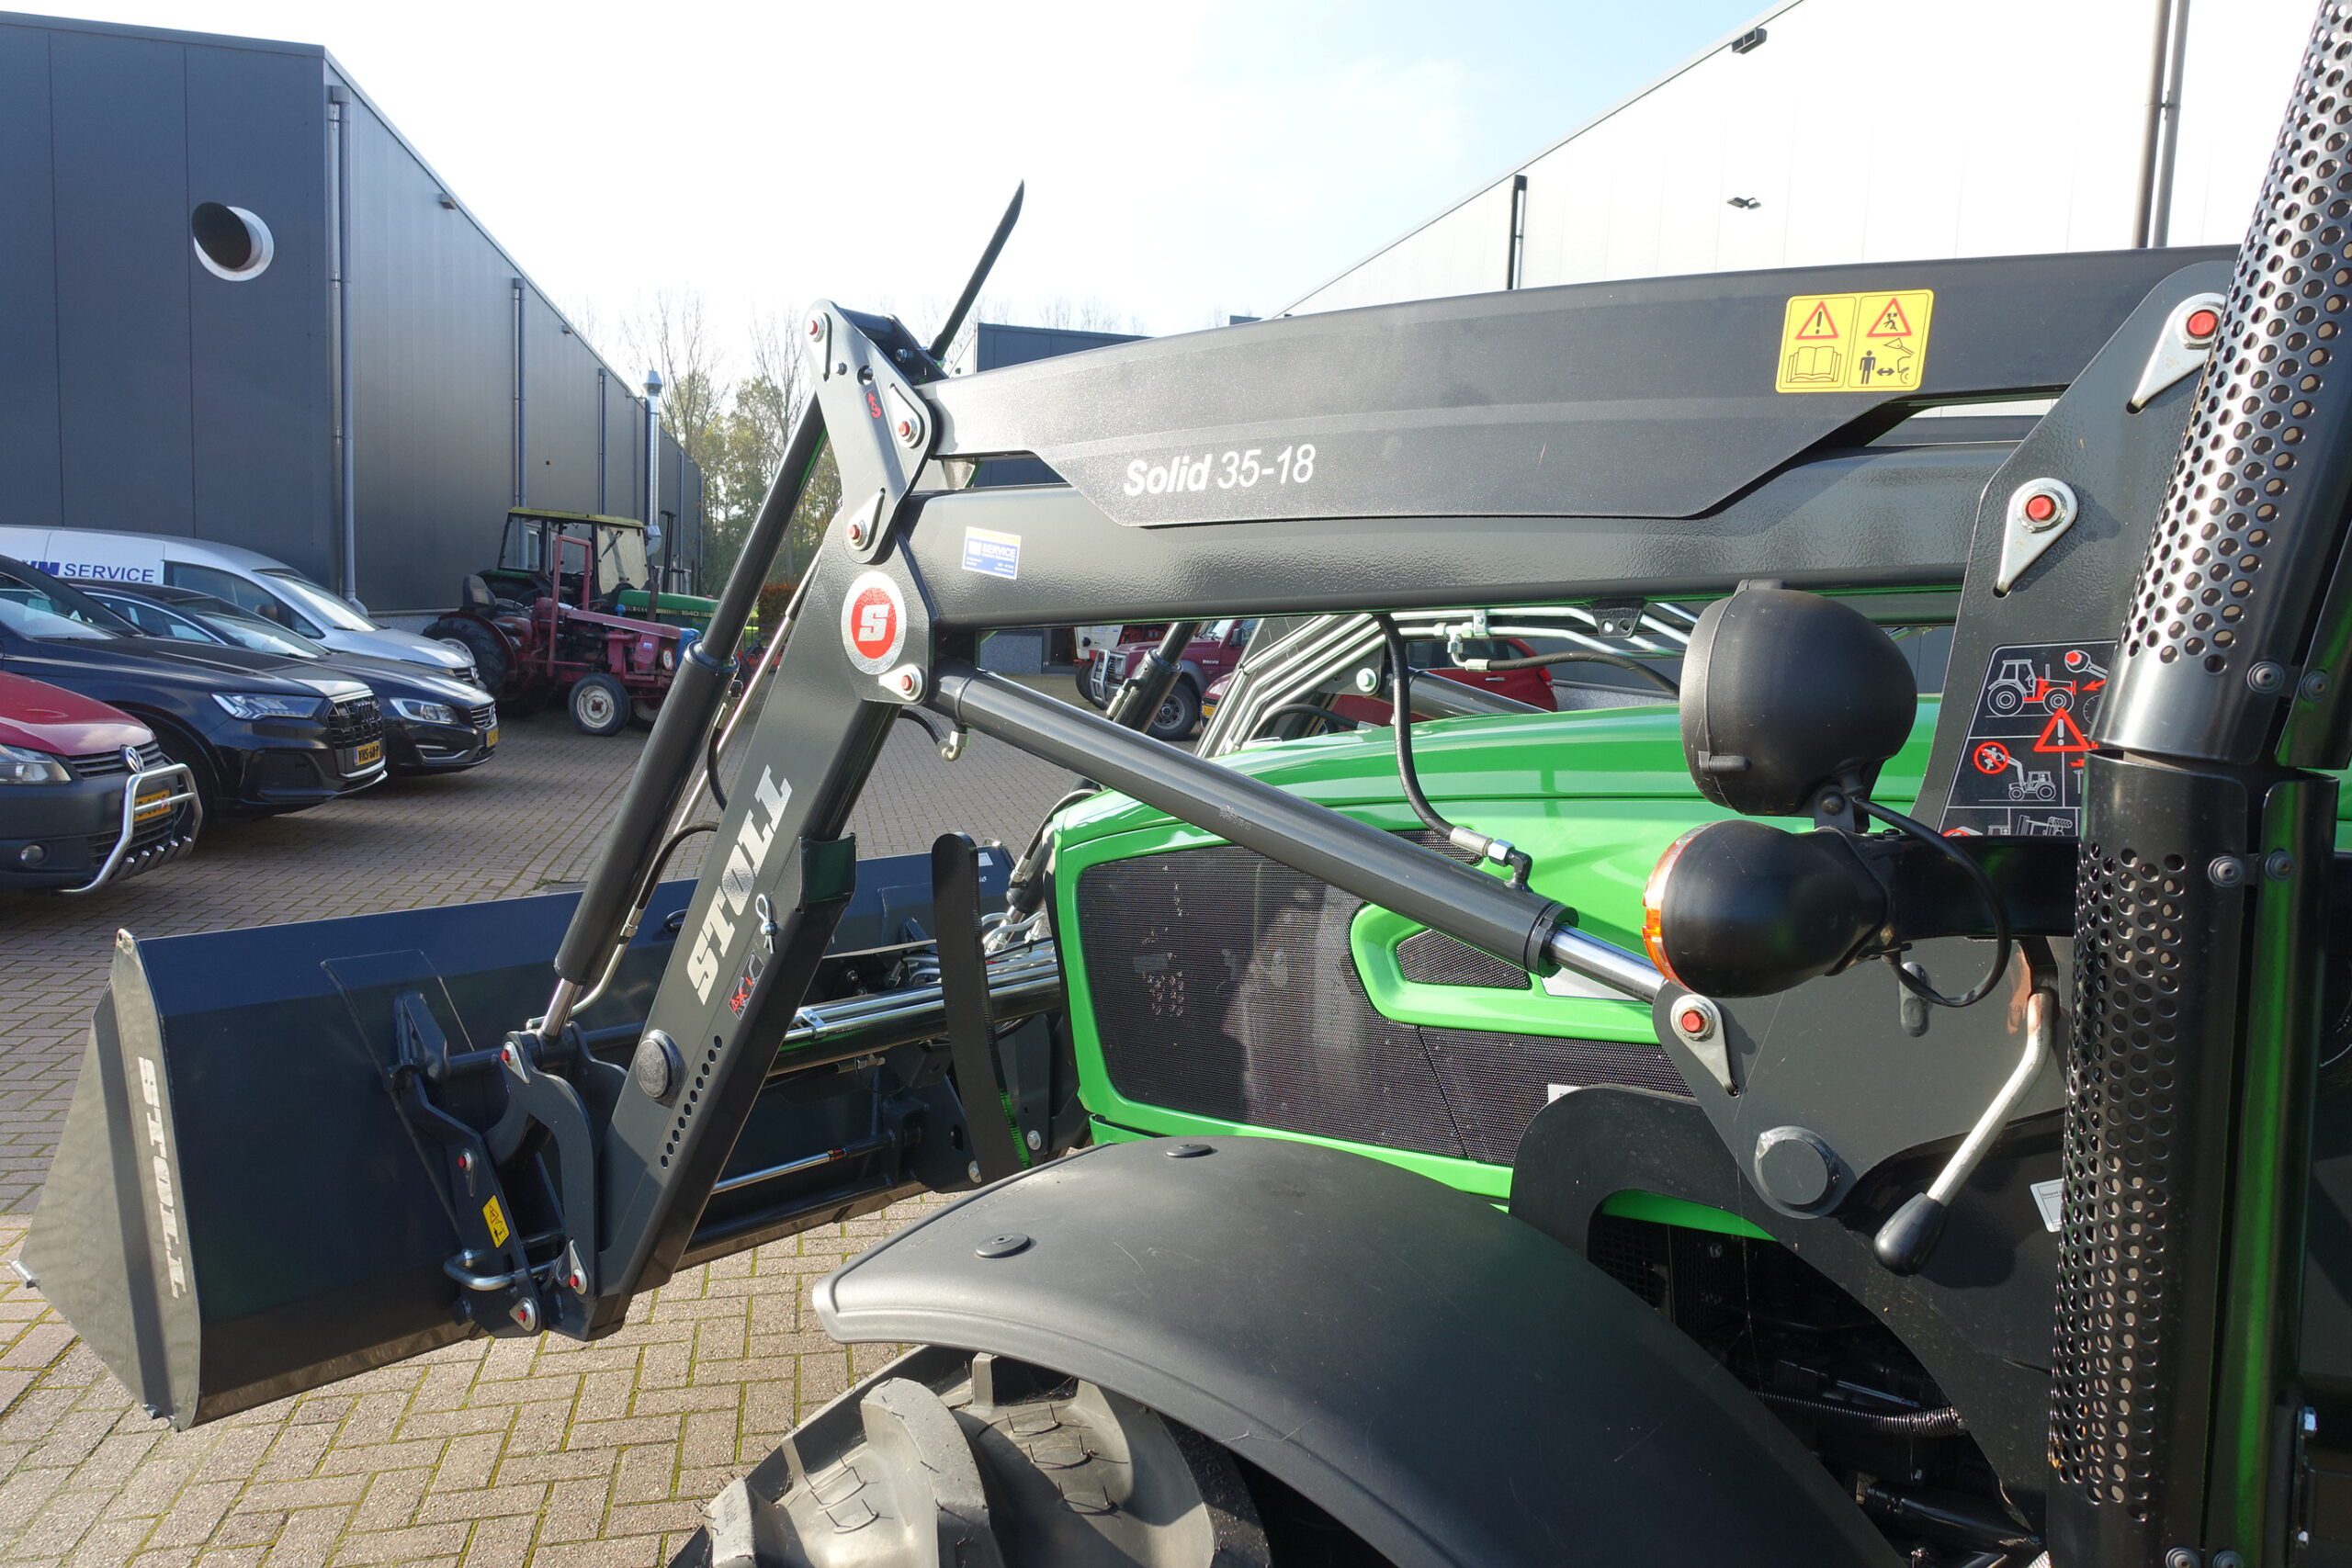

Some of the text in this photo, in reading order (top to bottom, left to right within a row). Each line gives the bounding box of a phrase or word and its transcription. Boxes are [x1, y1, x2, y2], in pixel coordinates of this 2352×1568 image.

[1123, 443, 1317, 496] Solid 35-18
[63, 562, 155, 583] SERVICE
[857, 603, 890, 642] S
[686, 763, 793, 1007] STOLL
[138, 1055, 187, 1300] STOLL
